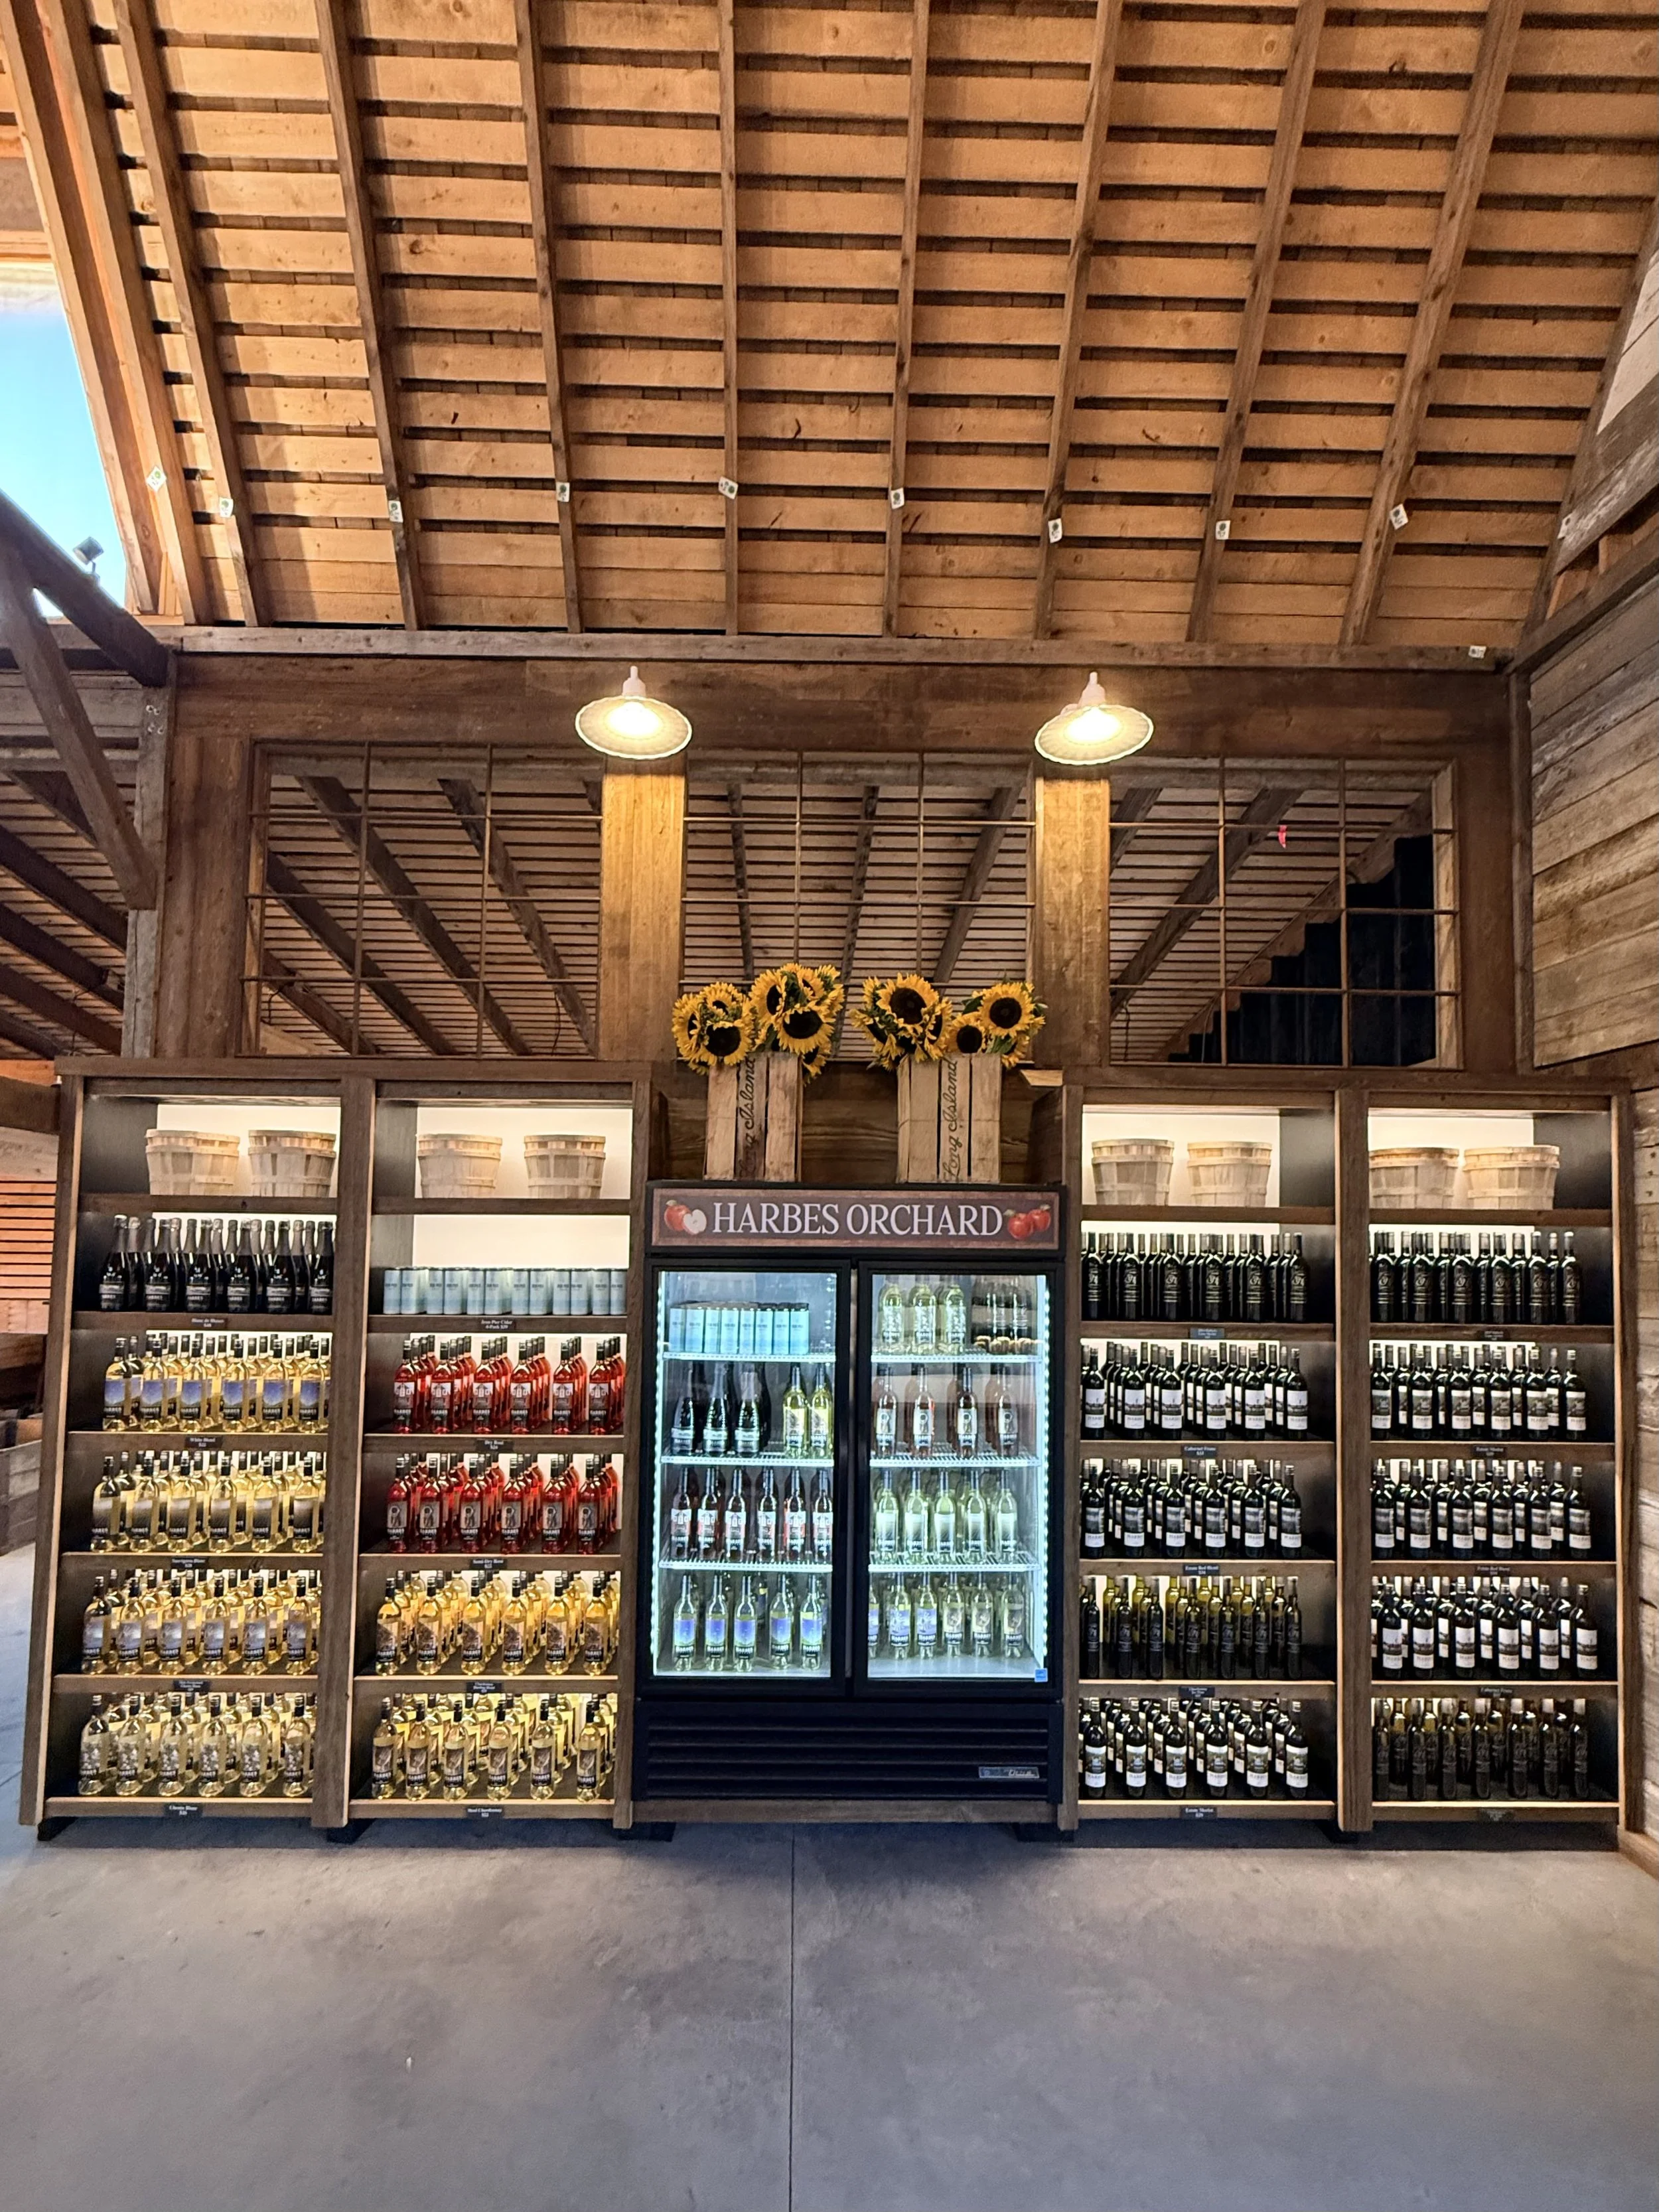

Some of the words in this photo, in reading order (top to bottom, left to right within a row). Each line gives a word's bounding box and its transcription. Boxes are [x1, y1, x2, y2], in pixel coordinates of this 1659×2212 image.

[943, 1057, 958, 1132] Island
[943, 1136, 962, 1181] Long
[712, 1203, 839, 1235] HARBES
[846, 1203, 1003, 1236] ORCHARD
